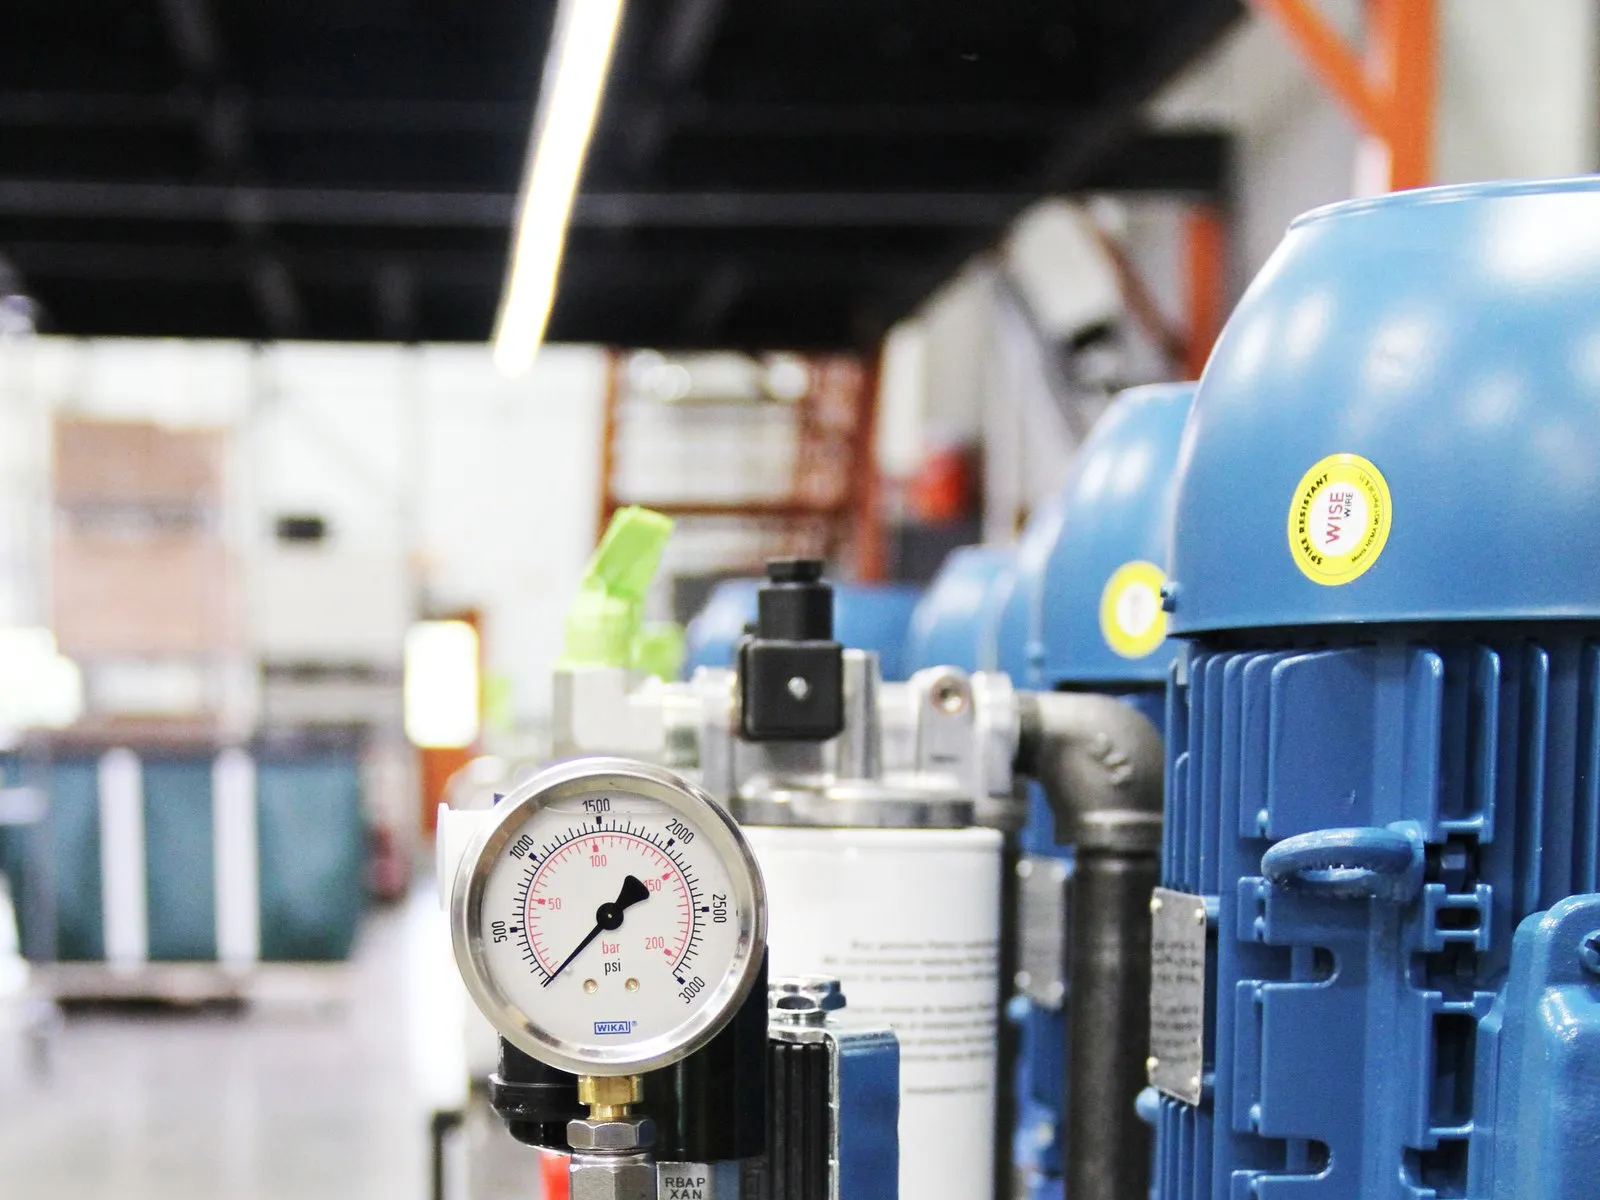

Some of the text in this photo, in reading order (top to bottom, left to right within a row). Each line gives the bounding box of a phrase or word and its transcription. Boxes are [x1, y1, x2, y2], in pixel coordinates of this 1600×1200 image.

[1344, 492, 1353, 518] WIRE
[1299, 473, 1328, 565] SPIKE RESISTANT
[1325, 492, 1344, 544] WISE
[582, 798, 610, 813] 1500
[665, 818, 695, 845] 2000
[509, 834, 534, 861] 1000
[591, 855, 607, 867] 100
[643, 879, 661, 892] 150
[548, 899, 561, 910] 50
[712, 894, 726, 923] 2500
[491, 920, 507, 943] 500
[602, 941, 620, 955] bar
[645, 937, 664, 950] 200
[604, 959, 621, 975] psi
[678, 976, 706, 1004] 3000
[596, 1023, 627, 1033] WIKA
[665, 1177, 706, 1188] RBAP
[670, 1189, 703, 1200] XAN
